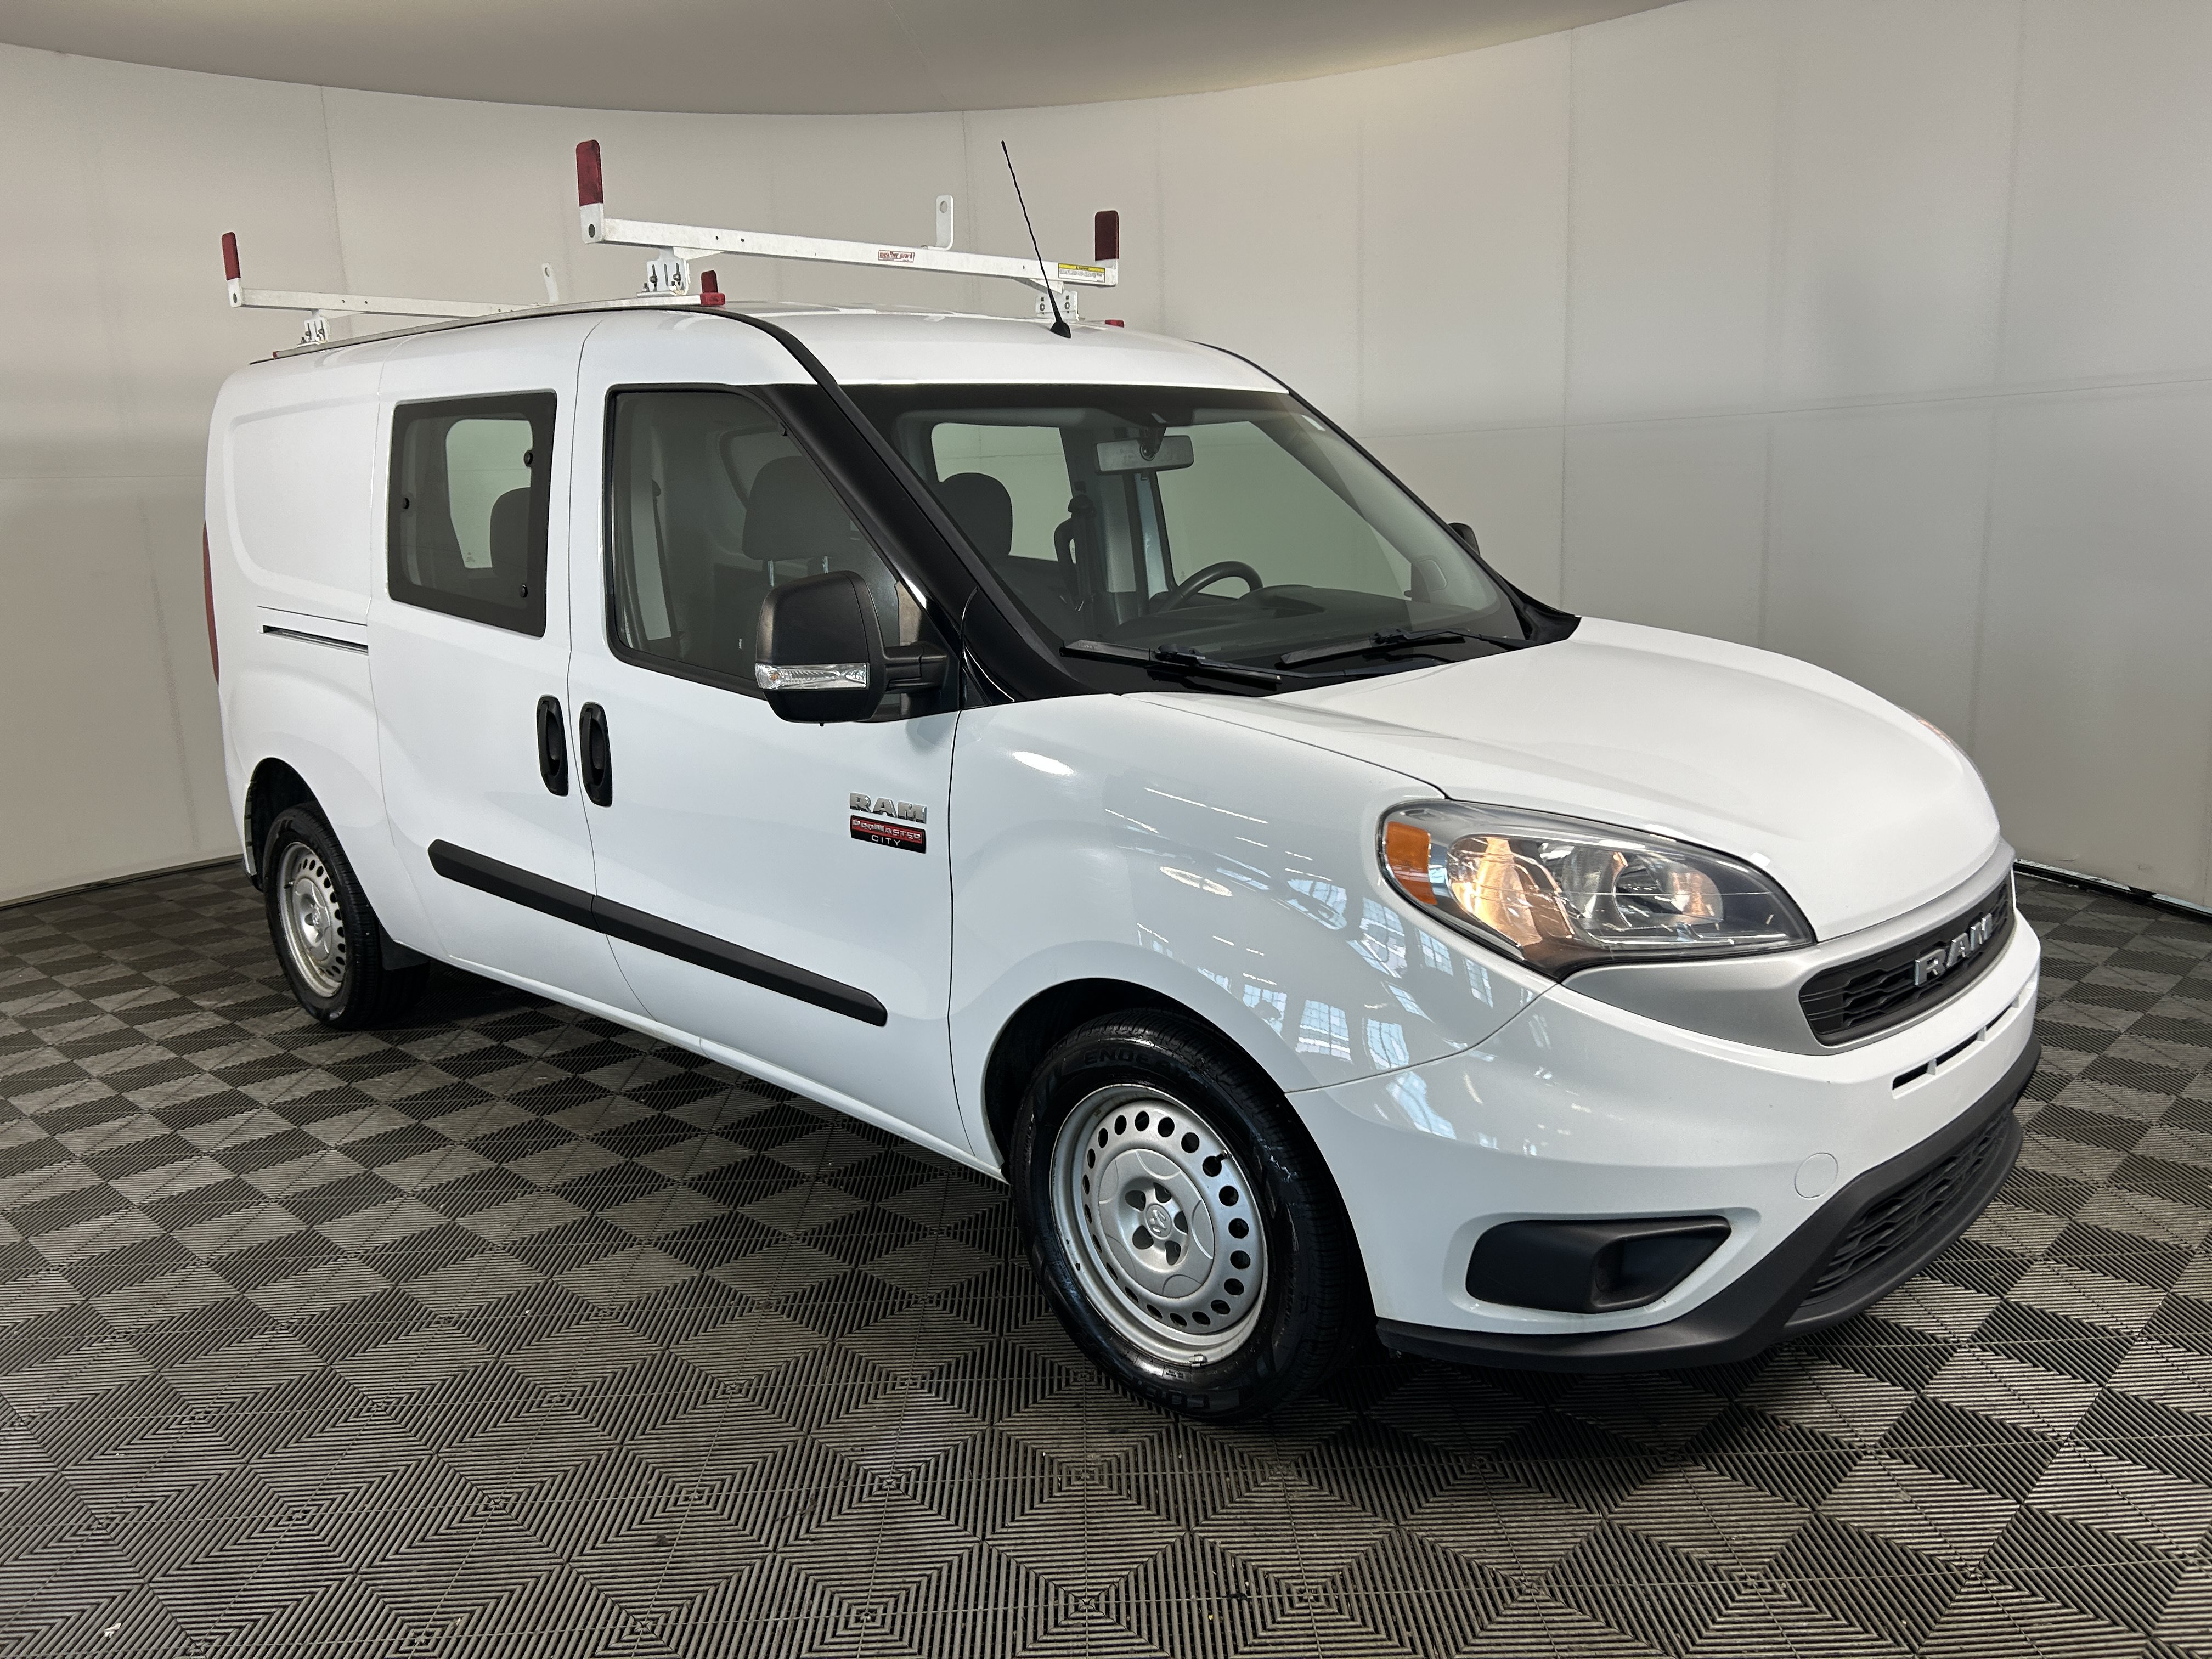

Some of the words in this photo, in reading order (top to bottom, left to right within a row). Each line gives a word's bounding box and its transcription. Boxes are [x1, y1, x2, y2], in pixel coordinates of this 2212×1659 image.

[849, 792, 927, 824] RAM
[871, 835, 901, 847] CITY
[1914, 913, 1993, 986] RAM
